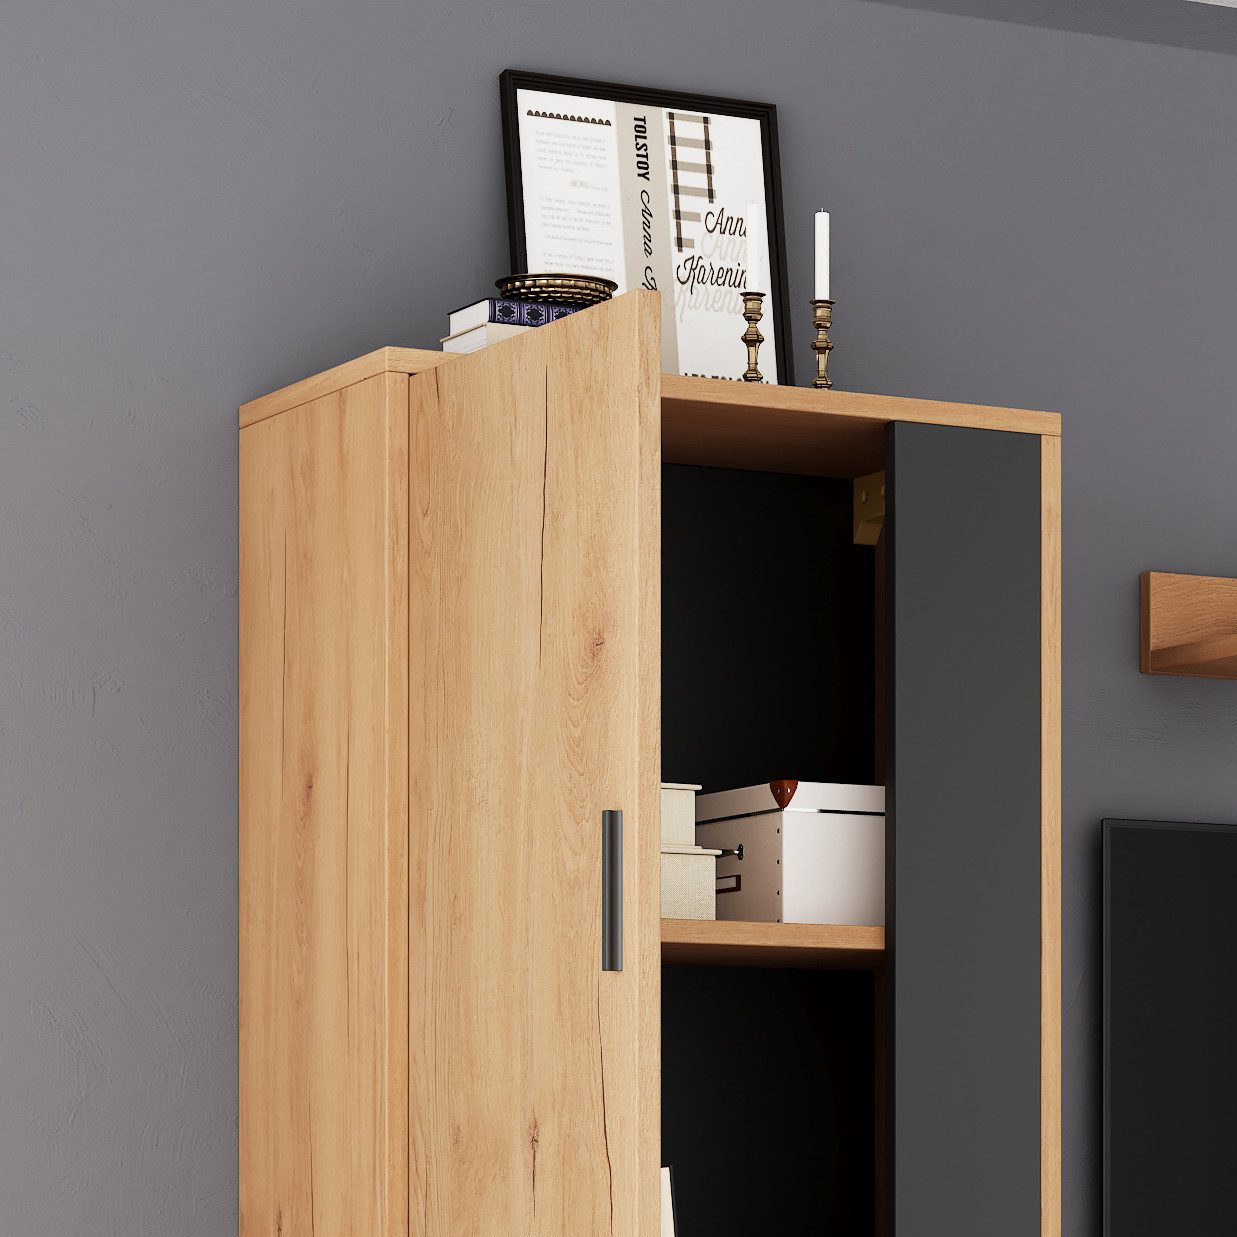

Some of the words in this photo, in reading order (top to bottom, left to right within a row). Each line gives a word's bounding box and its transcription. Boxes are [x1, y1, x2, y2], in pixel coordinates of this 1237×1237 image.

[633, 116, 650, 181] TOLSTOY
[640, 189, 653, 259] Anna
[676, 255, 747, 295] Karenin
